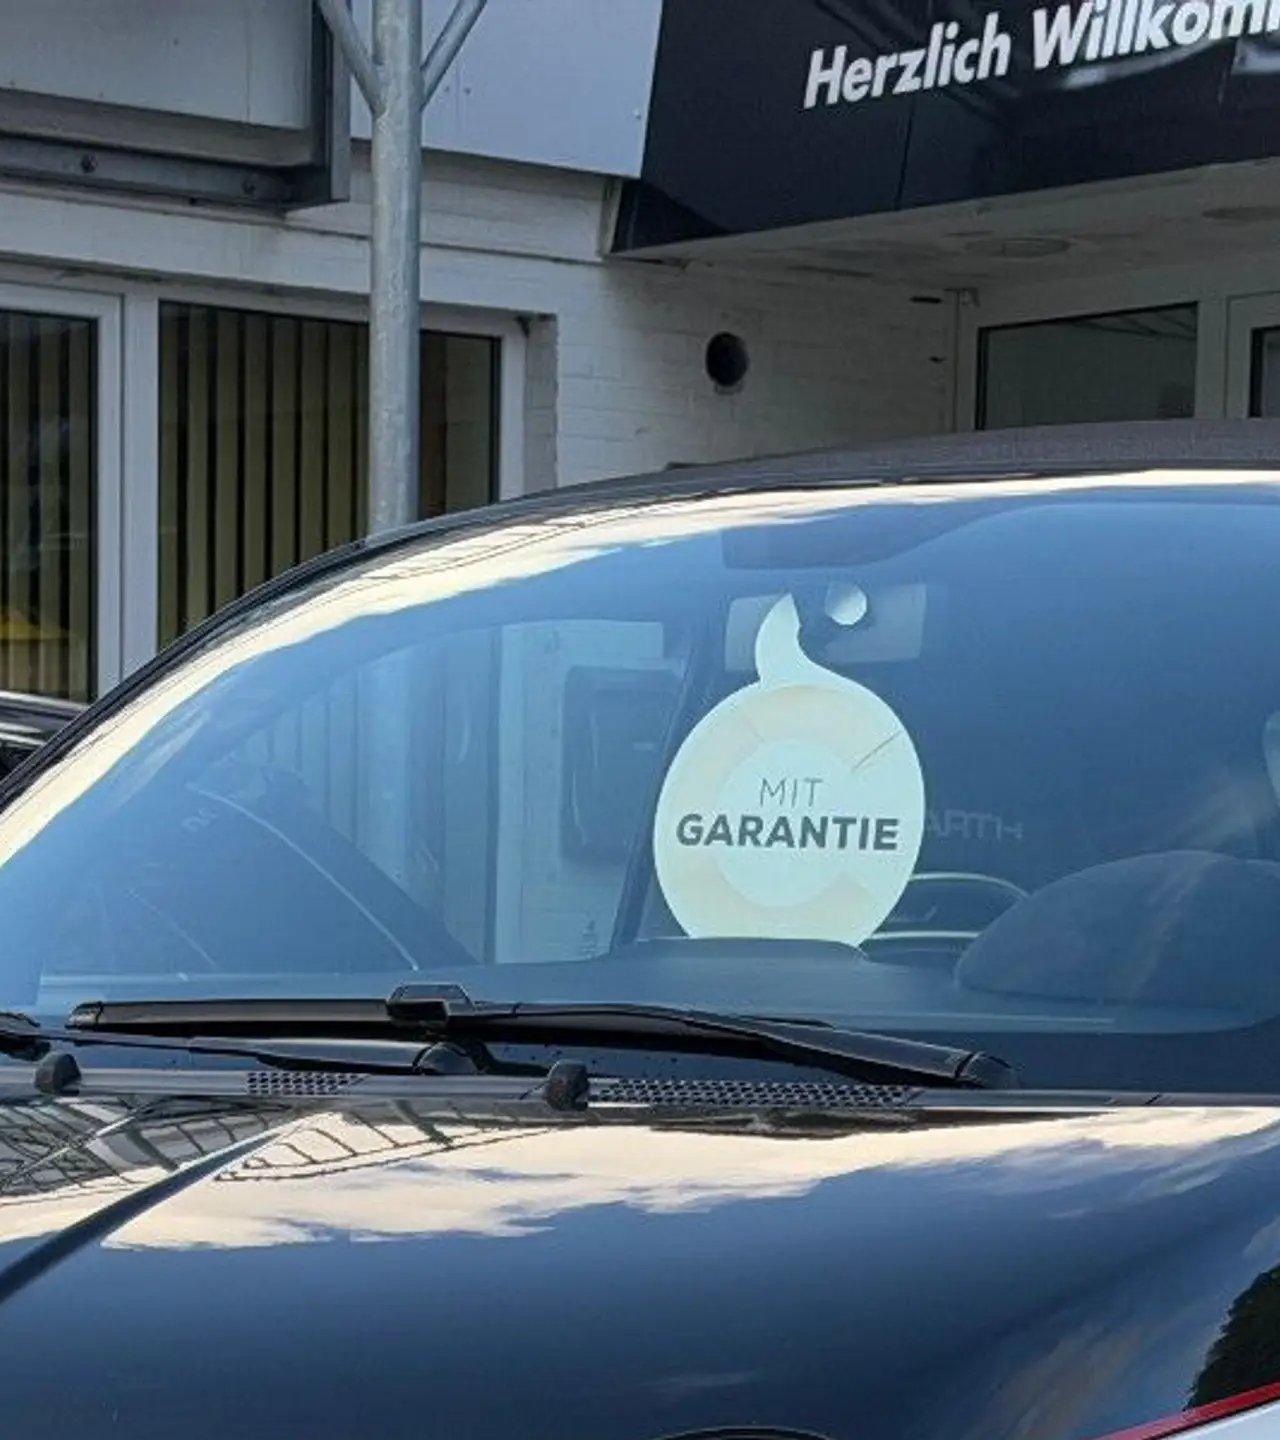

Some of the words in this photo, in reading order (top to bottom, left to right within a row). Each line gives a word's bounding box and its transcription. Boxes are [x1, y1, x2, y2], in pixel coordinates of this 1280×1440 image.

[803, 12, 1012, 109] Herzlich
[759, 777, 823, 807] MIT
[676, 813, 900, 851] GARANTIE
